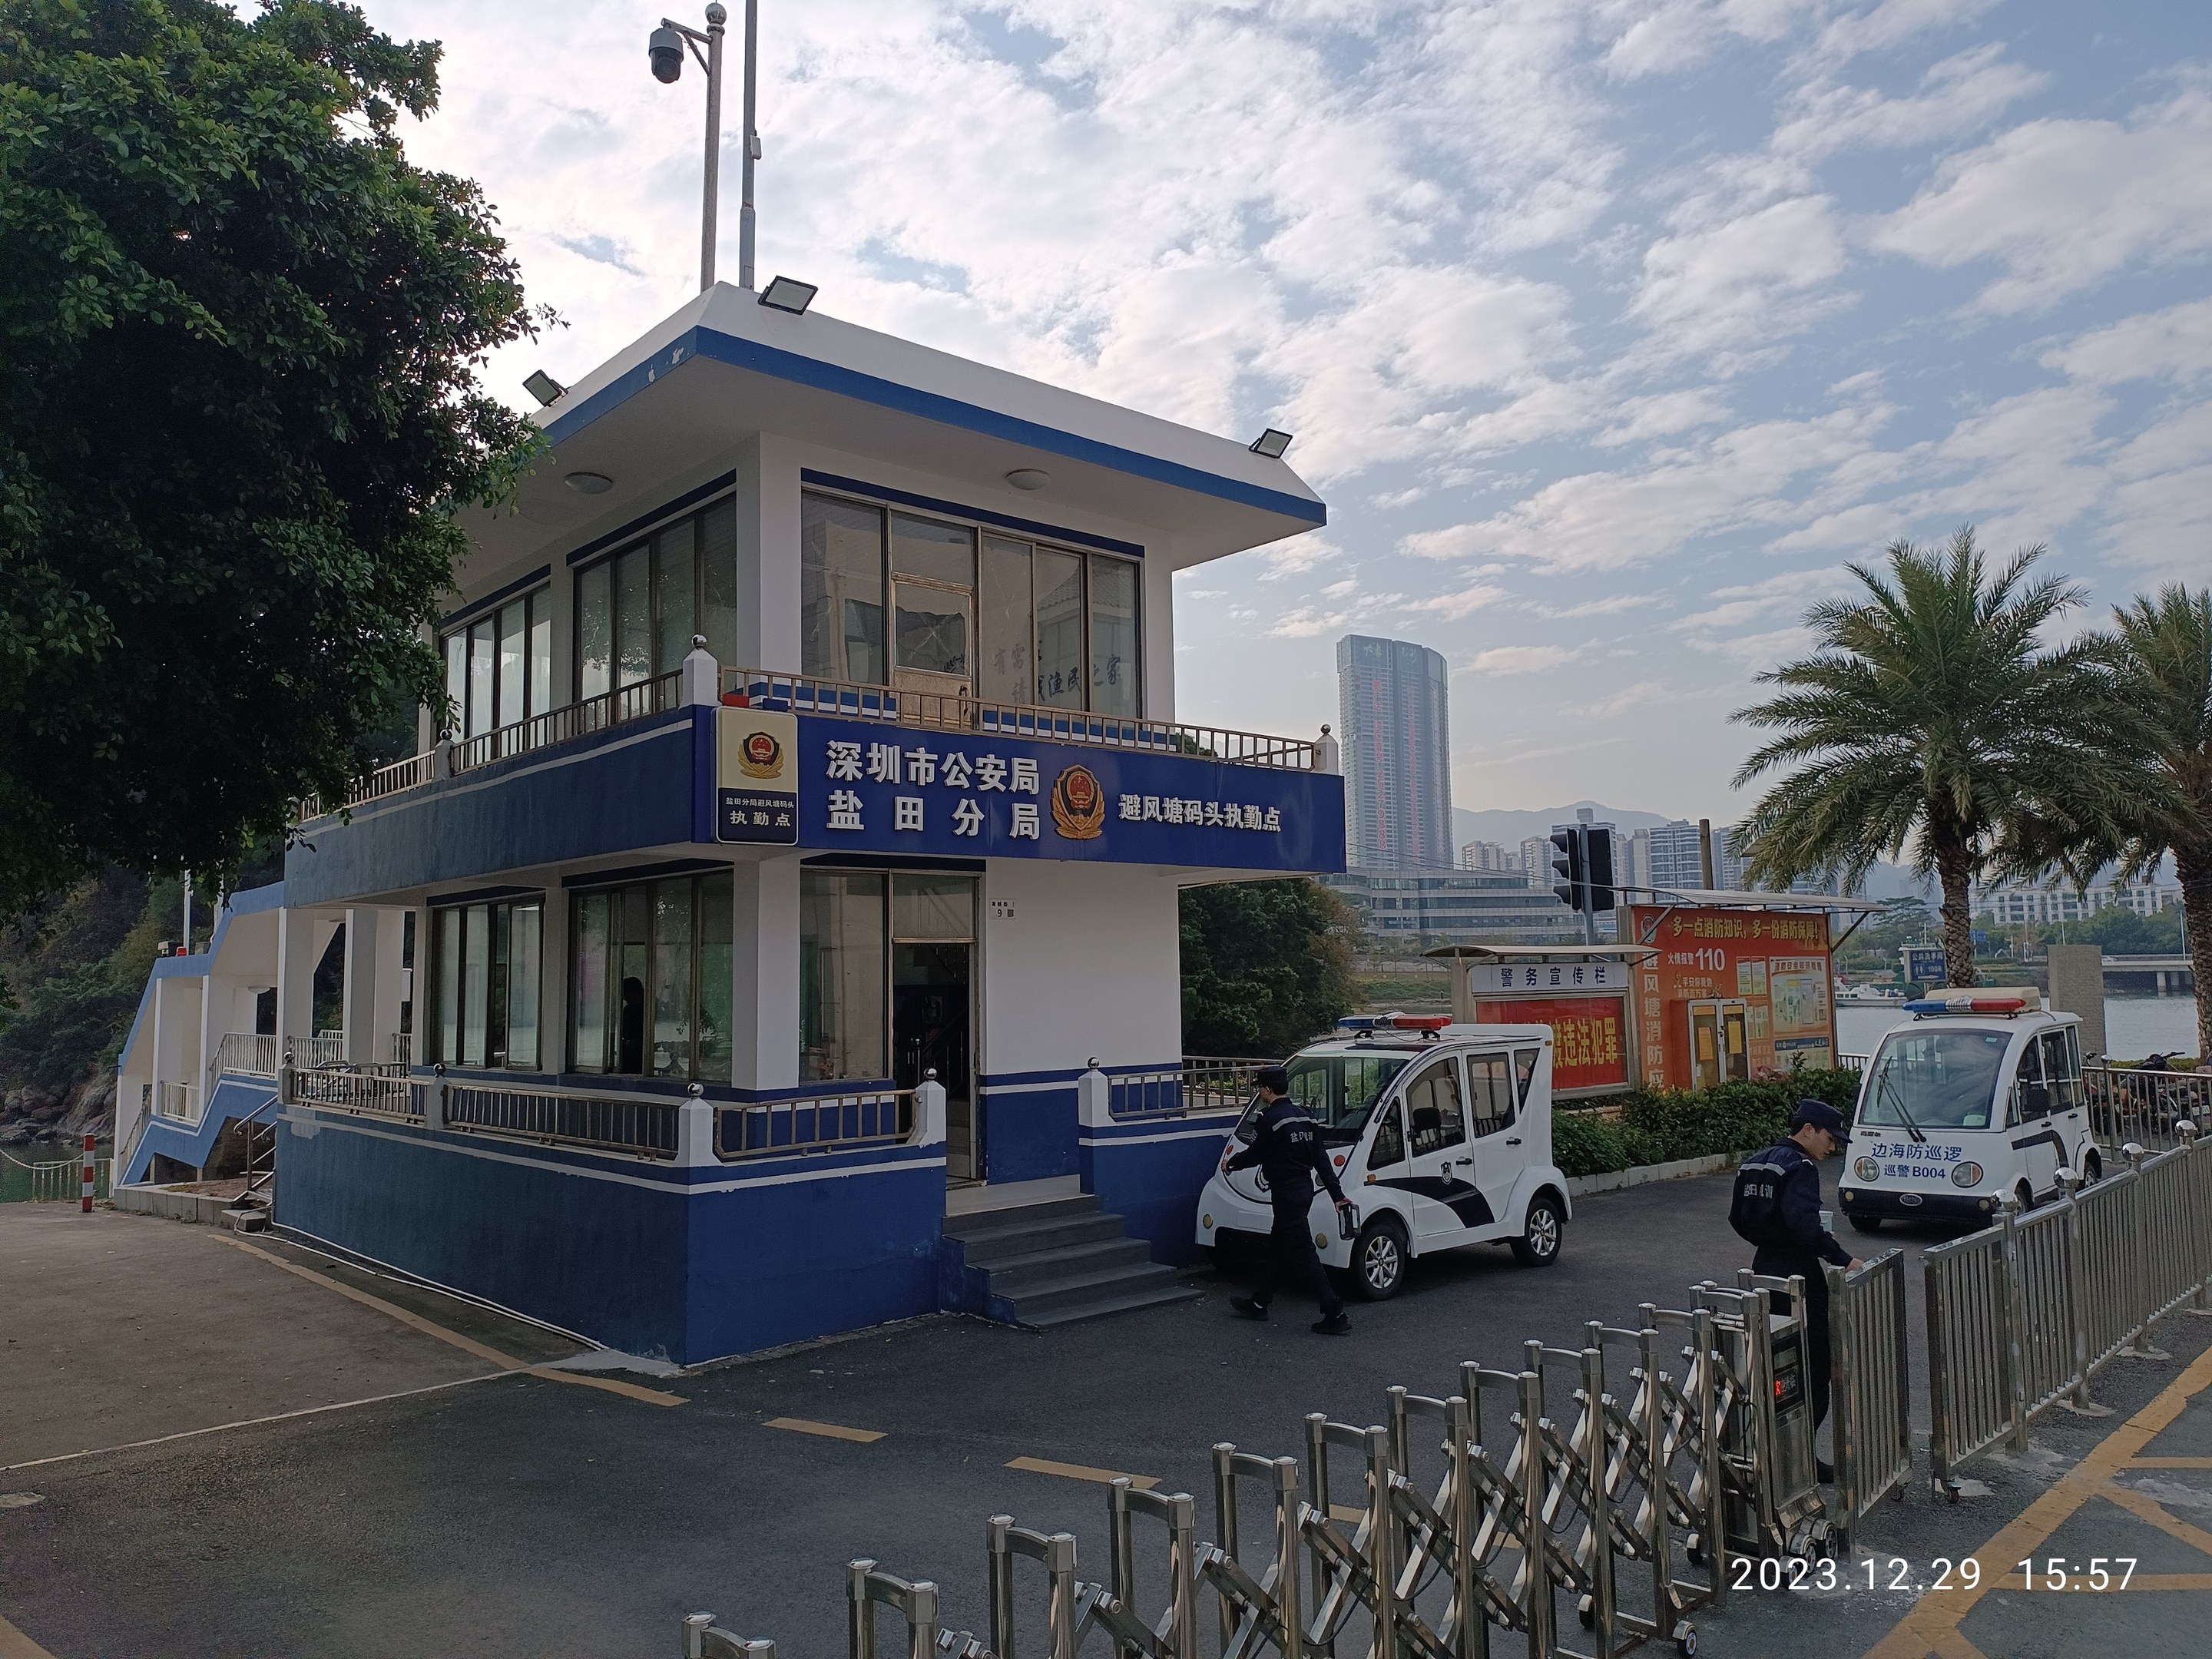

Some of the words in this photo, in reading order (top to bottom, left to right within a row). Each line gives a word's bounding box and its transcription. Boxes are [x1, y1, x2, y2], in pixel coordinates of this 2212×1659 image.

[826, 740, 1040, 795] 深圳市公安局
[725, 796, 795, 809] 盐田分局避风塘码头
[1119, 793, 1281, 833] 避风塘码头执勤点
[1376, 769, 1386, 849] 25279888
[730, 810, 791, 826] 执勤点
[827, 790, 1040, 840] 盐田分局
[997, 909, 1002, 917] 9
[1501, 966, 1606, 988] 警务宣传栏
[1872, 1142, 1962, 1162] 边海防巡逻
